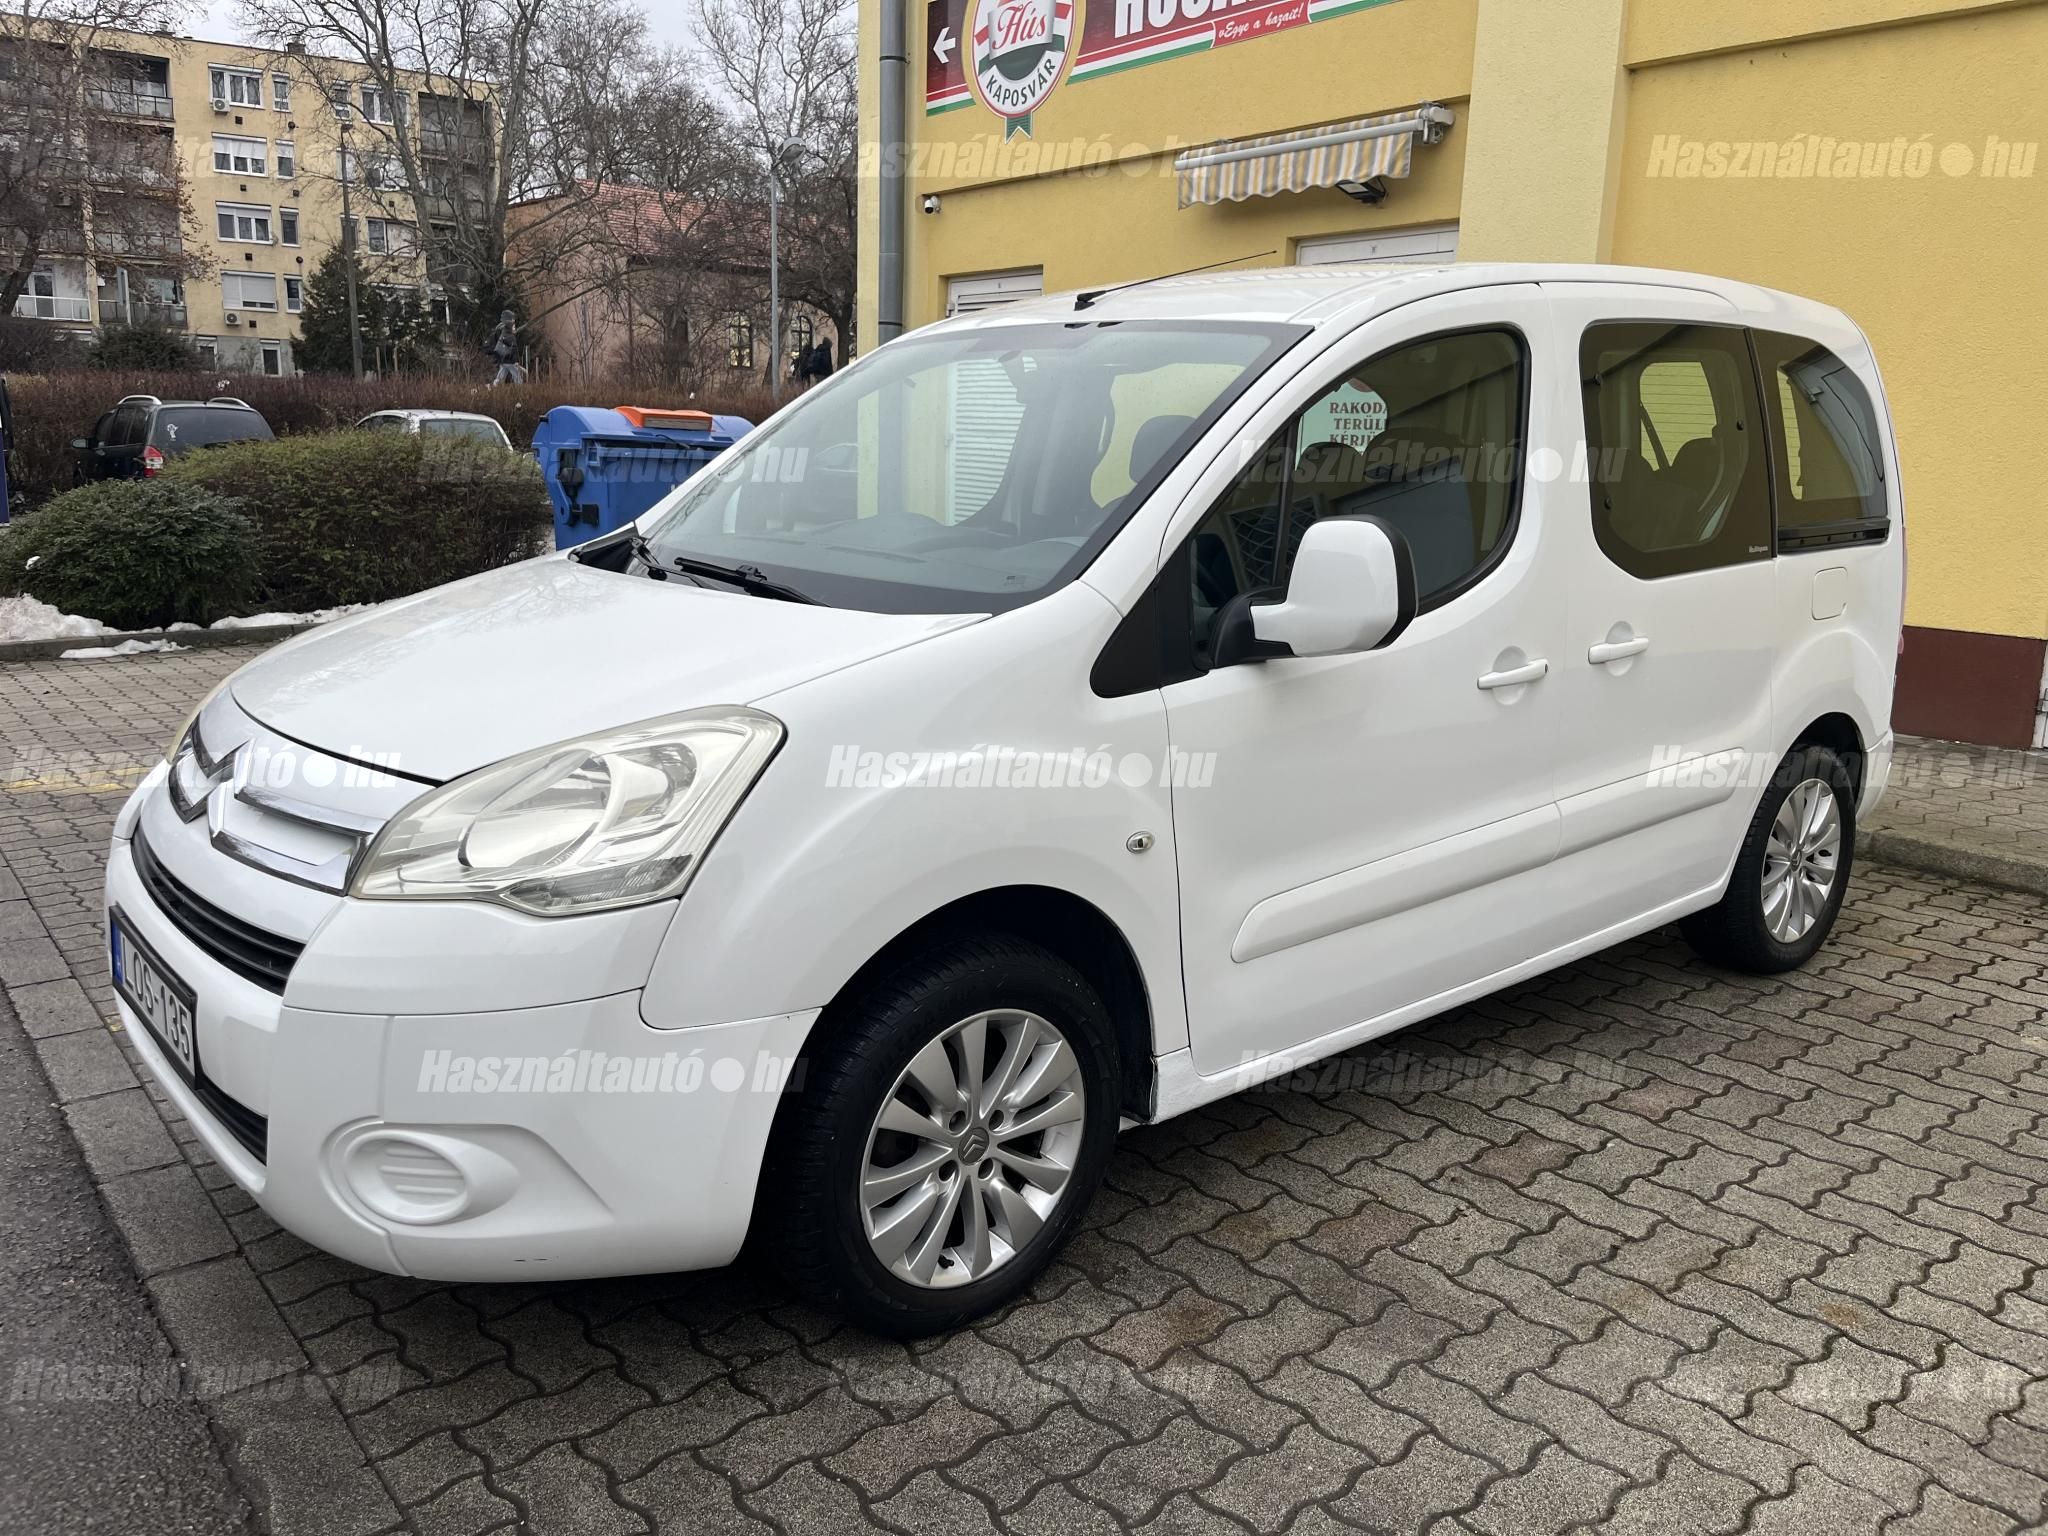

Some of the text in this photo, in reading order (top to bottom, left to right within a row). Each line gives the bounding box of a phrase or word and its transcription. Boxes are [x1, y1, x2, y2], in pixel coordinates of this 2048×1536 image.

[992, 1, 1047, 50] Hús
[1253, 20, 1261, 29] a
[986, 58, 1056, 107] KAPOSVÁR
[1334, 415, 1387, 431] TERÜL
[122, 936, 190, 1062] LOS-135
